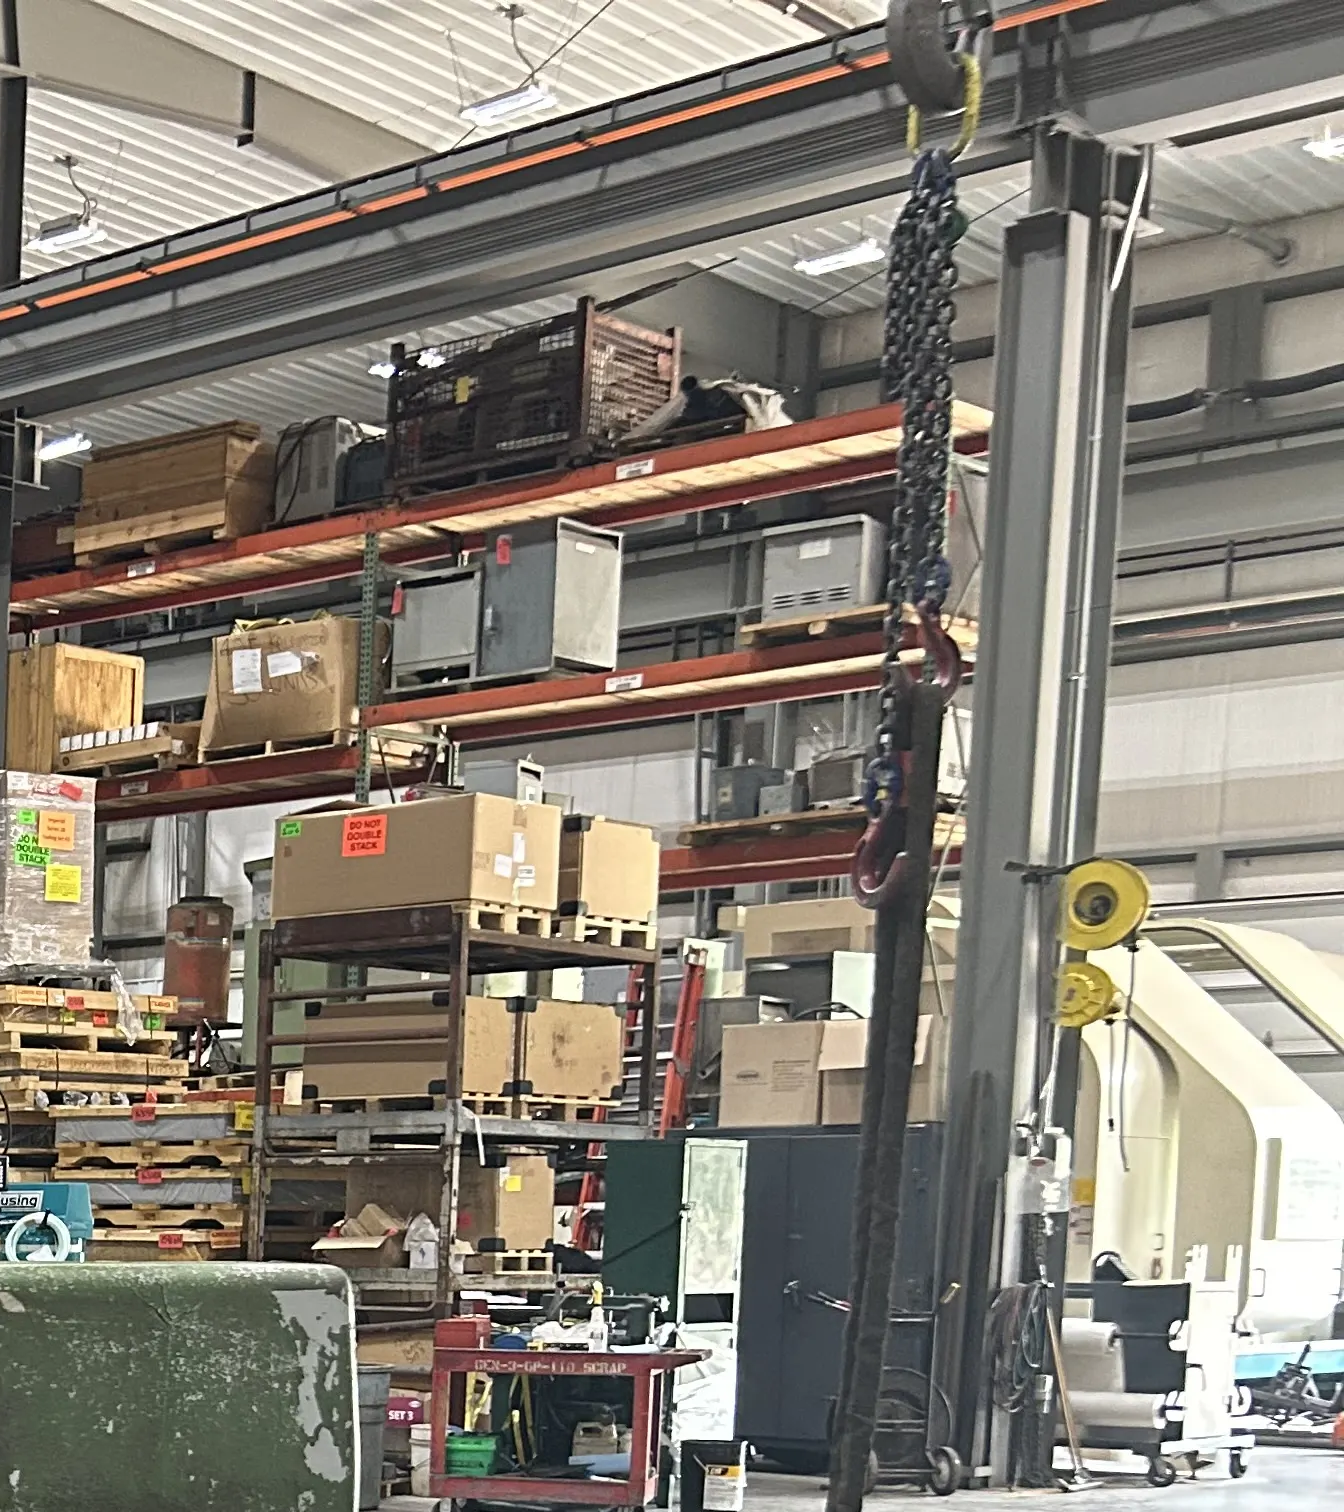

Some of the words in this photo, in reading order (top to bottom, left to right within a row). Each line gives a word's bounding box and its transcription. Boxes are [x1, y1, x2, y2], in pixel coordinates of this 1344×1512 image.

[349, 820, 362, 831] DO
[364, 819, 381, 830] NOT
[346, 830, 382, 841] DOUBLE
[350, 841, 378, 851] STACK
[18, 853, 48, 866] STACK
[583, 1361, 628, 1374] SCRAP
[388, 1410, 406, 1421] SET
[406, 1410, 415, 1421] 3
